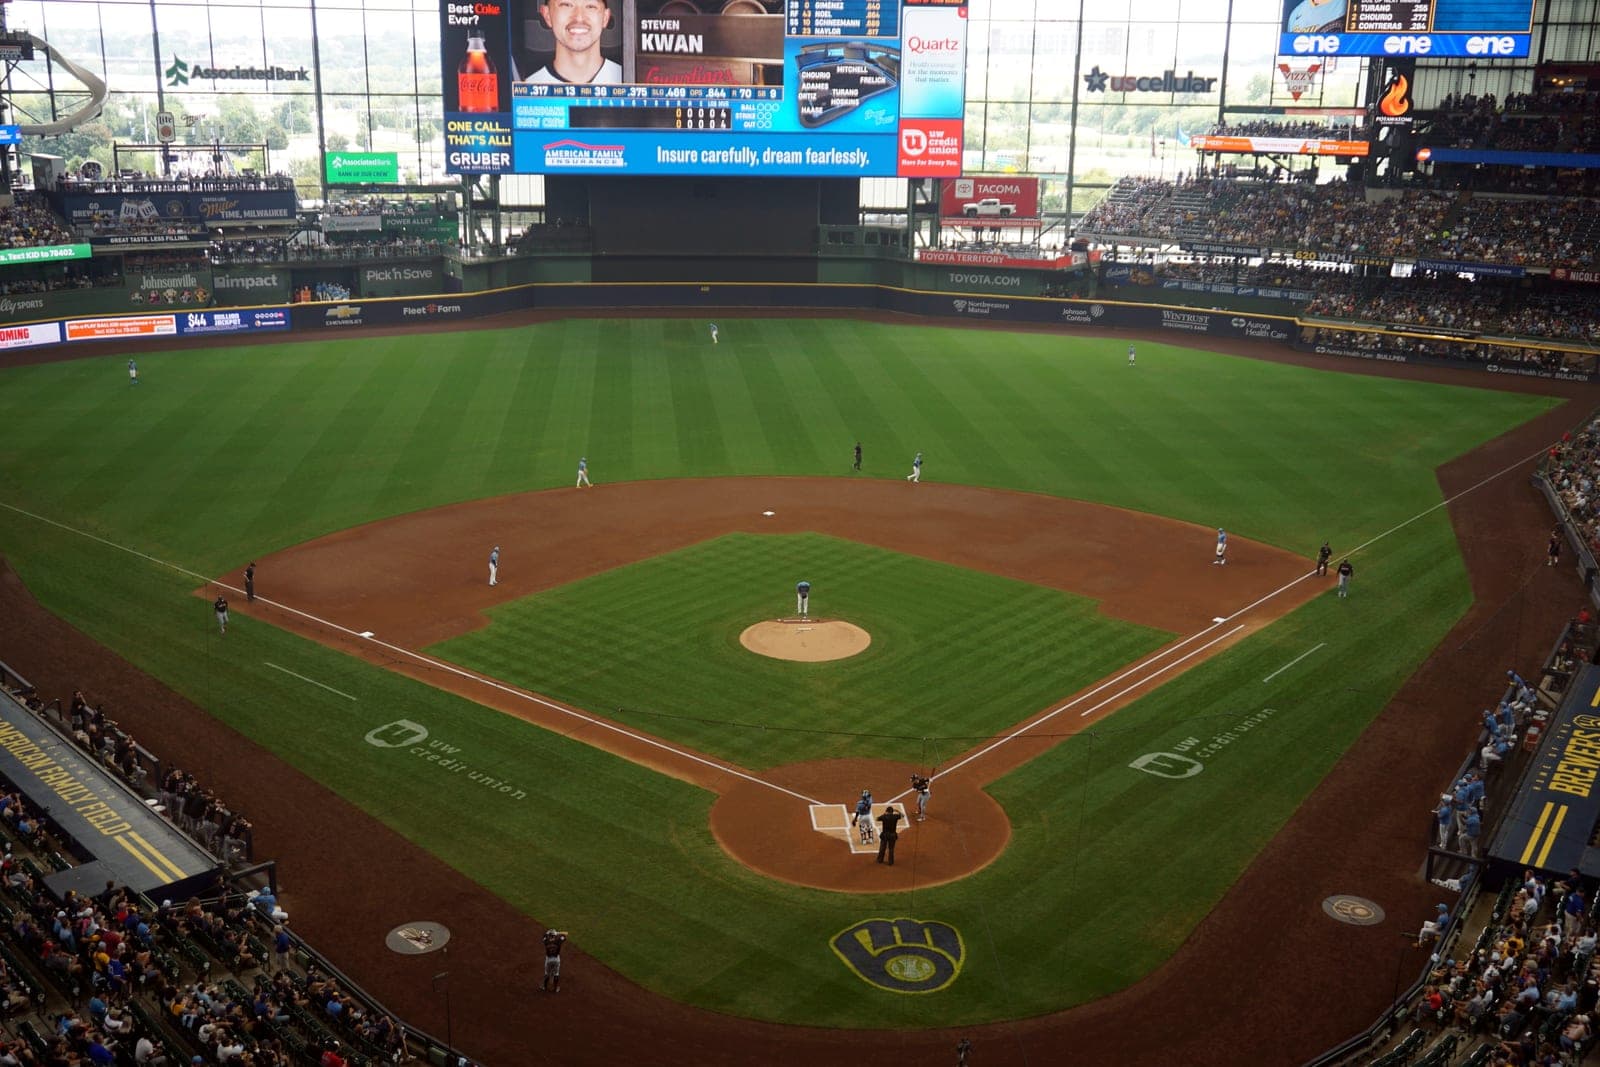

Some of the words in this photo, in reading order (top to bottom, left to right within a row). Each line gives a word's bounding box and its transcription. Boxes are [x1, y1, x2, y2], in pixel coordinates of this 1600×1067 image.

[448, 3, 474, 14] Best
[475, 4, 500, 15] Coke
[1361, 4, 1391, 12] TURANG
[814, 10, 832, 18] NOEL
[1360, 13, 1393, 21] CHOURIO
[448, 14, 480, 26] Ever?
[641, 20, 680, 31] STEVEN
[1359, 22, 1402, 30] CONTRERAS
[641, 33, 703, 53] KWAN
[908, 36, 959, 54] Quartz
[1293, 35, 1340, 54] one
[1383, 36, 1432, 55] one
[1466, 36, 1515, 55] one
[837, 65, 868, 73] MITCHELL
[801, 72, 831, 80] CHOURIO
[859, 76, 886, 85] FRELICK
[1110, 70, 1217, 93] uscellular
[1283, 72, 1315, 81] VIZZY
[530, 86, 549, 97] .317
[565, 86, 576, 97] 13
[627, 87, 648, 97] .375
[705, 88, 727, 99] .844
[739, 88, 752, 99] 70
[832, 89, 858, 97] TURANG
[675, 108, 682, 118] 0
[687, 108, 694, 118] 0
[698, 108, 705, 119] 0
[709, 108, 716, 119] 0
[447, 121, 473, 132] ONE
[675, 119, 682, 129] 0
[687, 119, 694, 129] 0
[698, 119, 705, 129] 0
[709, 119, 716, 129] 0
[448, 135, 486, 146] THAT'S
[488, 135, 512, 146] ALL!
[928, 137, 958, 146] credit
[545, 150, 591, 159] AMERICAN
[593, 151, 624, 160] FAMILY
[928, 146, 958, 155] union
[450, 152, 510, 166] GRUBER
[657, 146, 697, 163] Insure
[701, 147, 759, 166] carefully,
[762, 148, 802, 165] dream
[805, 148, 869, 168] fearlessly.
[977, 184, 1021, 194] TACOMA
[222, 210, 242, 218] TIME,
[243, 208, 288, 217] MILWAUKEE
[922, 252, 955, 262] TOYOTA
[957, 254, 1005, 264] TERRITORY
[1296, 251, 1316, 260] 620
[1318, 252, 1352, 262] WTMJ
[367, 270, 392, 280] Pick
[403, 269, 433, 279] Save
[949, 273, 1021, 286] TOYOTA.COM
[140, 275, 197, 290] Johnsonville
[224, 274, 278, 290] impact
[17, 300, 44, 310] SPORTS
[403, 307, 426, 315] Fleet
[437, 305, 460, 313] Farm
[1063, 308, 1087, 316] Johnson
[1163, 311, 1210, 323] WINTRUST
[188, 313, 206, 328] $44
[1066, 314, 1091, 322] Controls
[1246, 321, 1271, 330] Aurora
[1245, 328, 1270, 337] Health
[1195, 731, 1240, 758] credit
[1234, 707, 1278, 732] union
[429, 739, 462, 754] uw
[1173, 736, 1200, 752] uw
[1548, 729, 1600, 798] BREWERS
[410, 746, 467, 773] credit
[467, 771, 528, 801] union
[35, 765, 99, 805] FAMILY
[76, 801, 132, 835] FIELD
